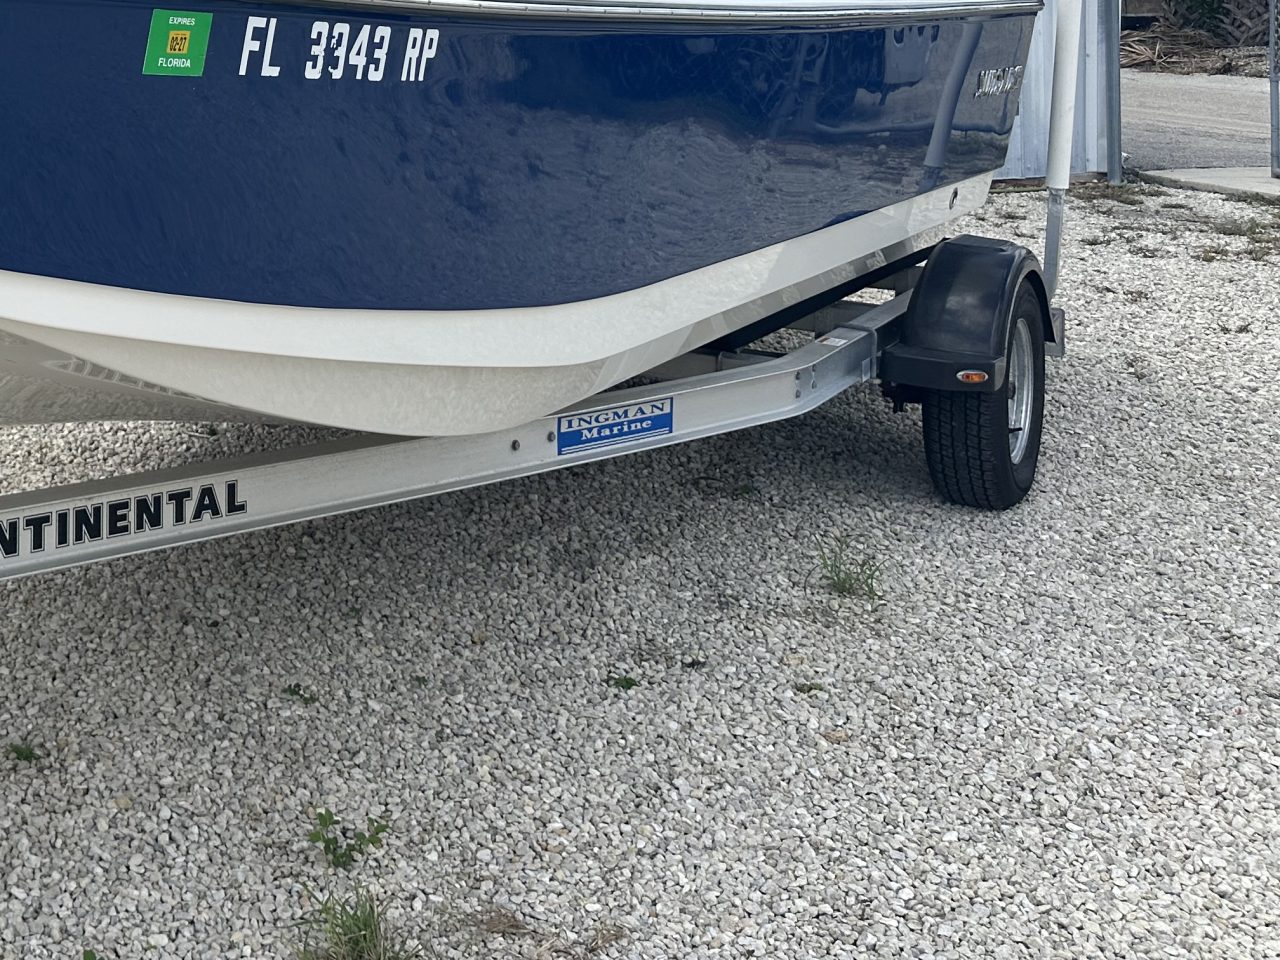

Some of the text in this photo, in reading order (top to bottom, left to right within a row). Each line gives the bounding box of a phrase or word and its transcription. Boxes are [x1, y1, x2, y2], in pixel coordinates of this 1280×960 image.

[168, 16, 196, 26] EXPIRES
[238, 15, 440, 82] FL 3343 RP
[157, 57, 191, 68] FLORIDA
[565, 402, 666, 430] INGMAN
[580, 419, 652, 440] Marine
